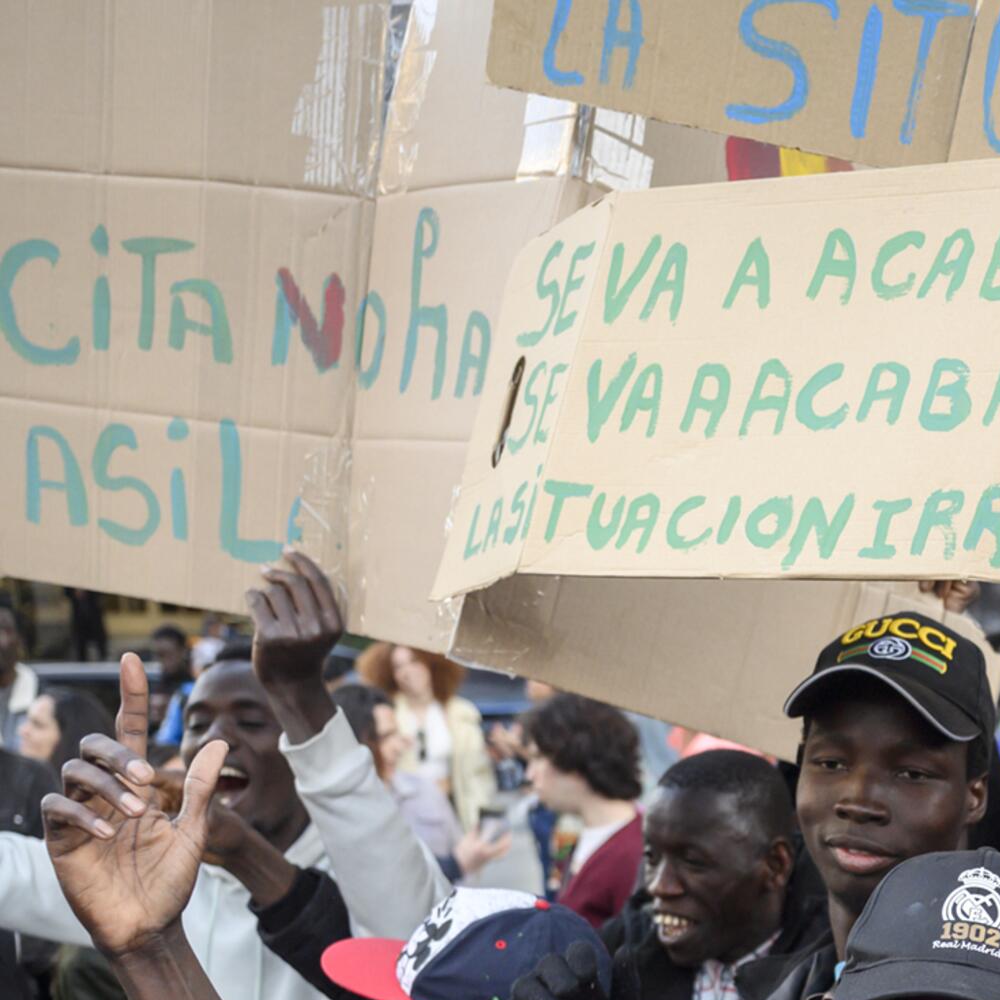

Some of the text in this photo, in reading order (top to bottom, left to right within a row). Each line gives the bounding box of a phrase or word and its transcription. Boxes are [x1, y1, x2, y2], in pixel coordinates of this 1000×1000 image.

[543, 0, 643, 89] LA
[516, 240, 596, 347] SE
[604, 234, 688, 326] VA
[723, 236, 771, 308] A
[507, 362, 569, 457] SE
[587, 352, 664, 444] VA
[679, 362, 731, 438] A
[841, 617, 957, 661] GUCCI
[932, 939, 960, 949] Real
